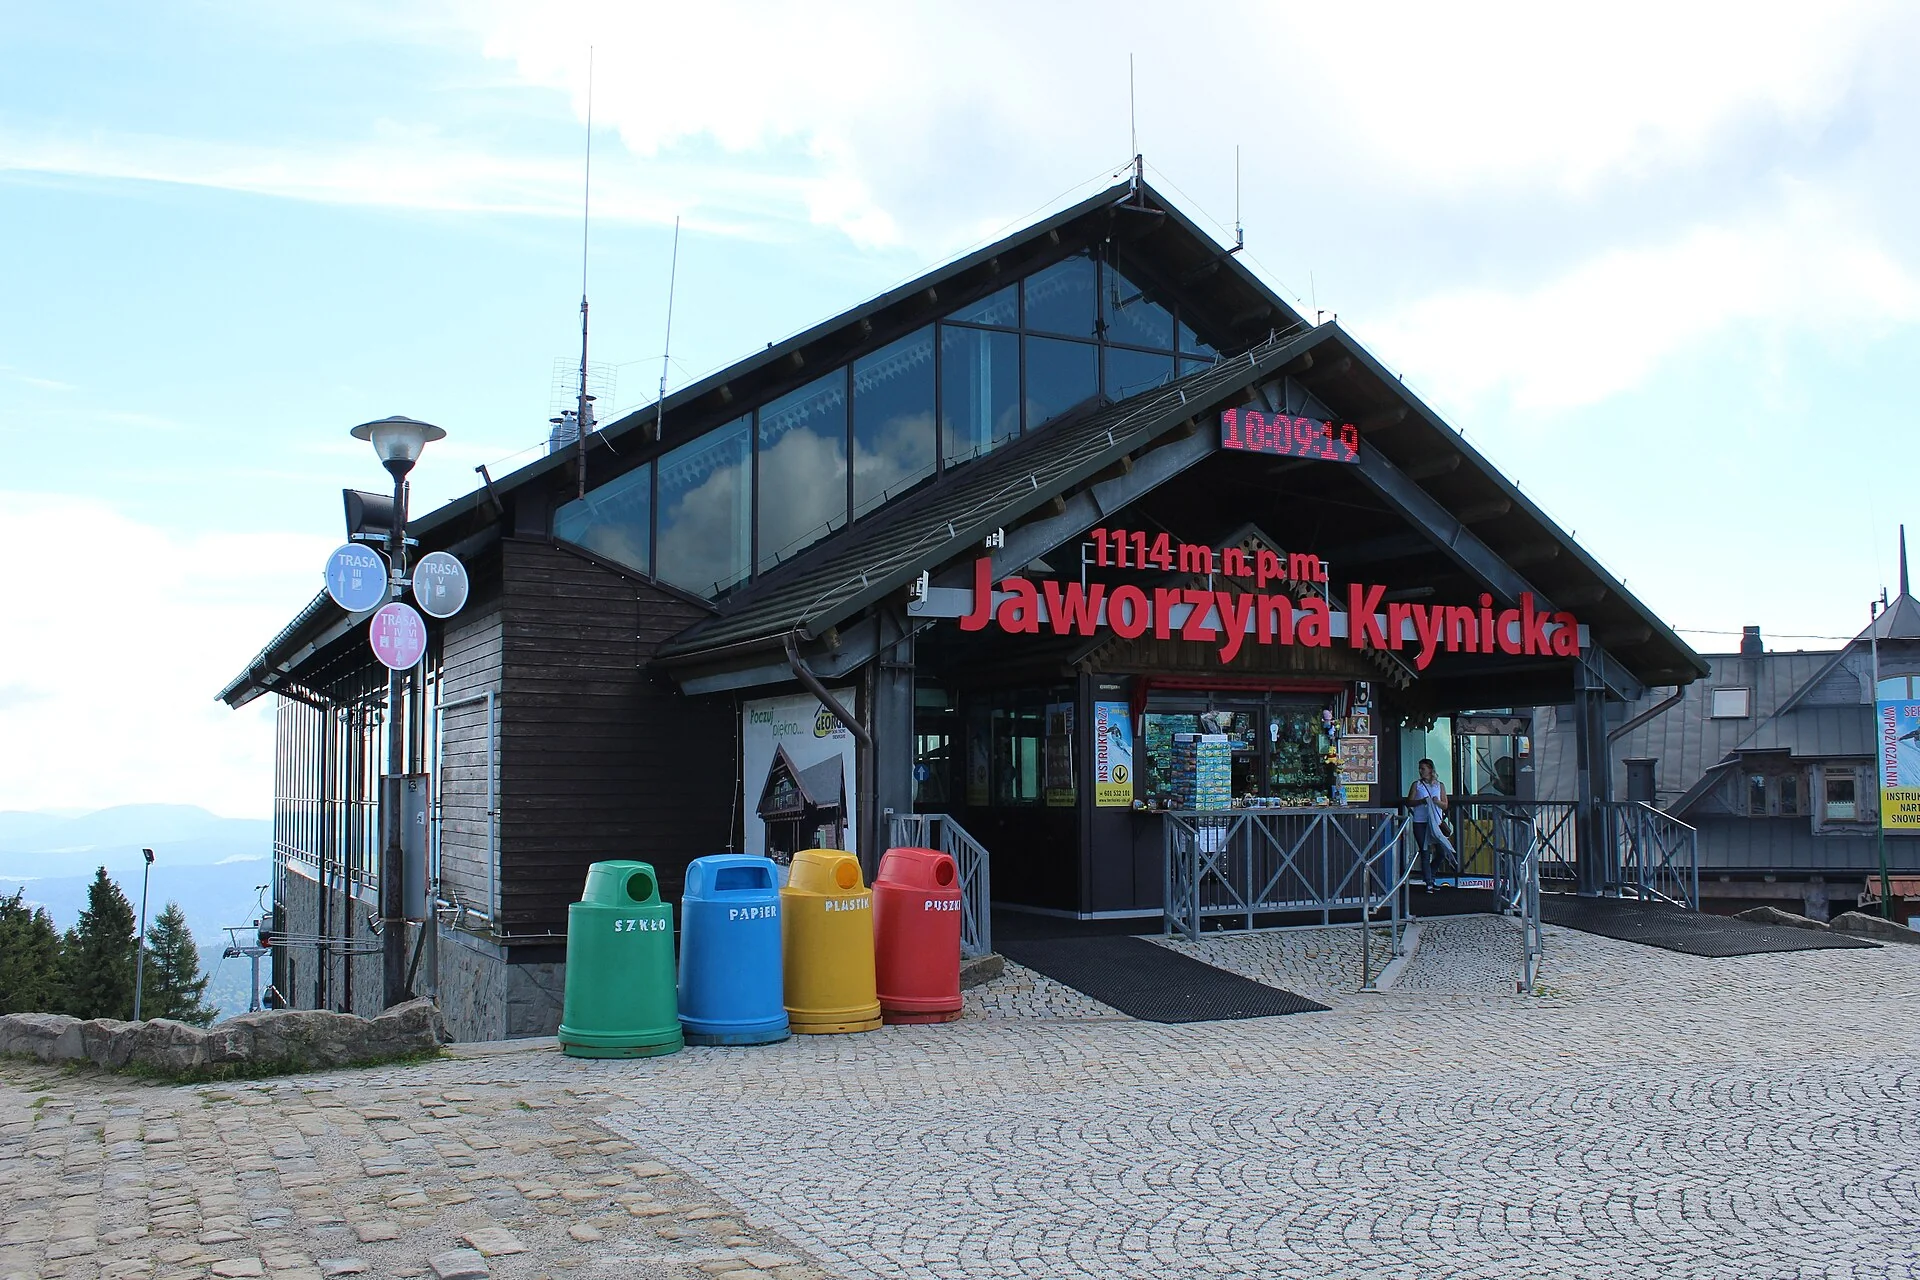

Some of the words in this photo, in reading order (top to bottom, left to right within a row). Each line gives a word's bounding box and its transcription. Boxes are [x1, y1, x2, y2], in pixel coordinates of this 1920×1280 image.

[1223, 408, 1358, 462] 10:09:19
[1091, 528, 1173, 571] 1114
[1178, 543, 1213, 574] m
[338, 553, 378, 569] TRASA
[353, 568, 362, 578] III
[424, 562, 459, 576] TRASA
[437, 576, 445, 585] V
[381, 613, 417, 628] TRASA
[959, 557, 1332, 664] Jaworzyna
[1348, 583, 1580, 670] Krynicka
[408, 629, 417, 638] VI
[750, 707, 774, 726] Poczuj
[815, 714, 847, 731] GEORG
[1098, 705, 1108, 783] INSTRUKTORZY
[825, 897, 869, 912] PLASTIK
[924, 899, 960, 911] PUSZKI
[729, 905, 777, 920] PAPIER
[614, 919, 666, 932] SZKŁO
